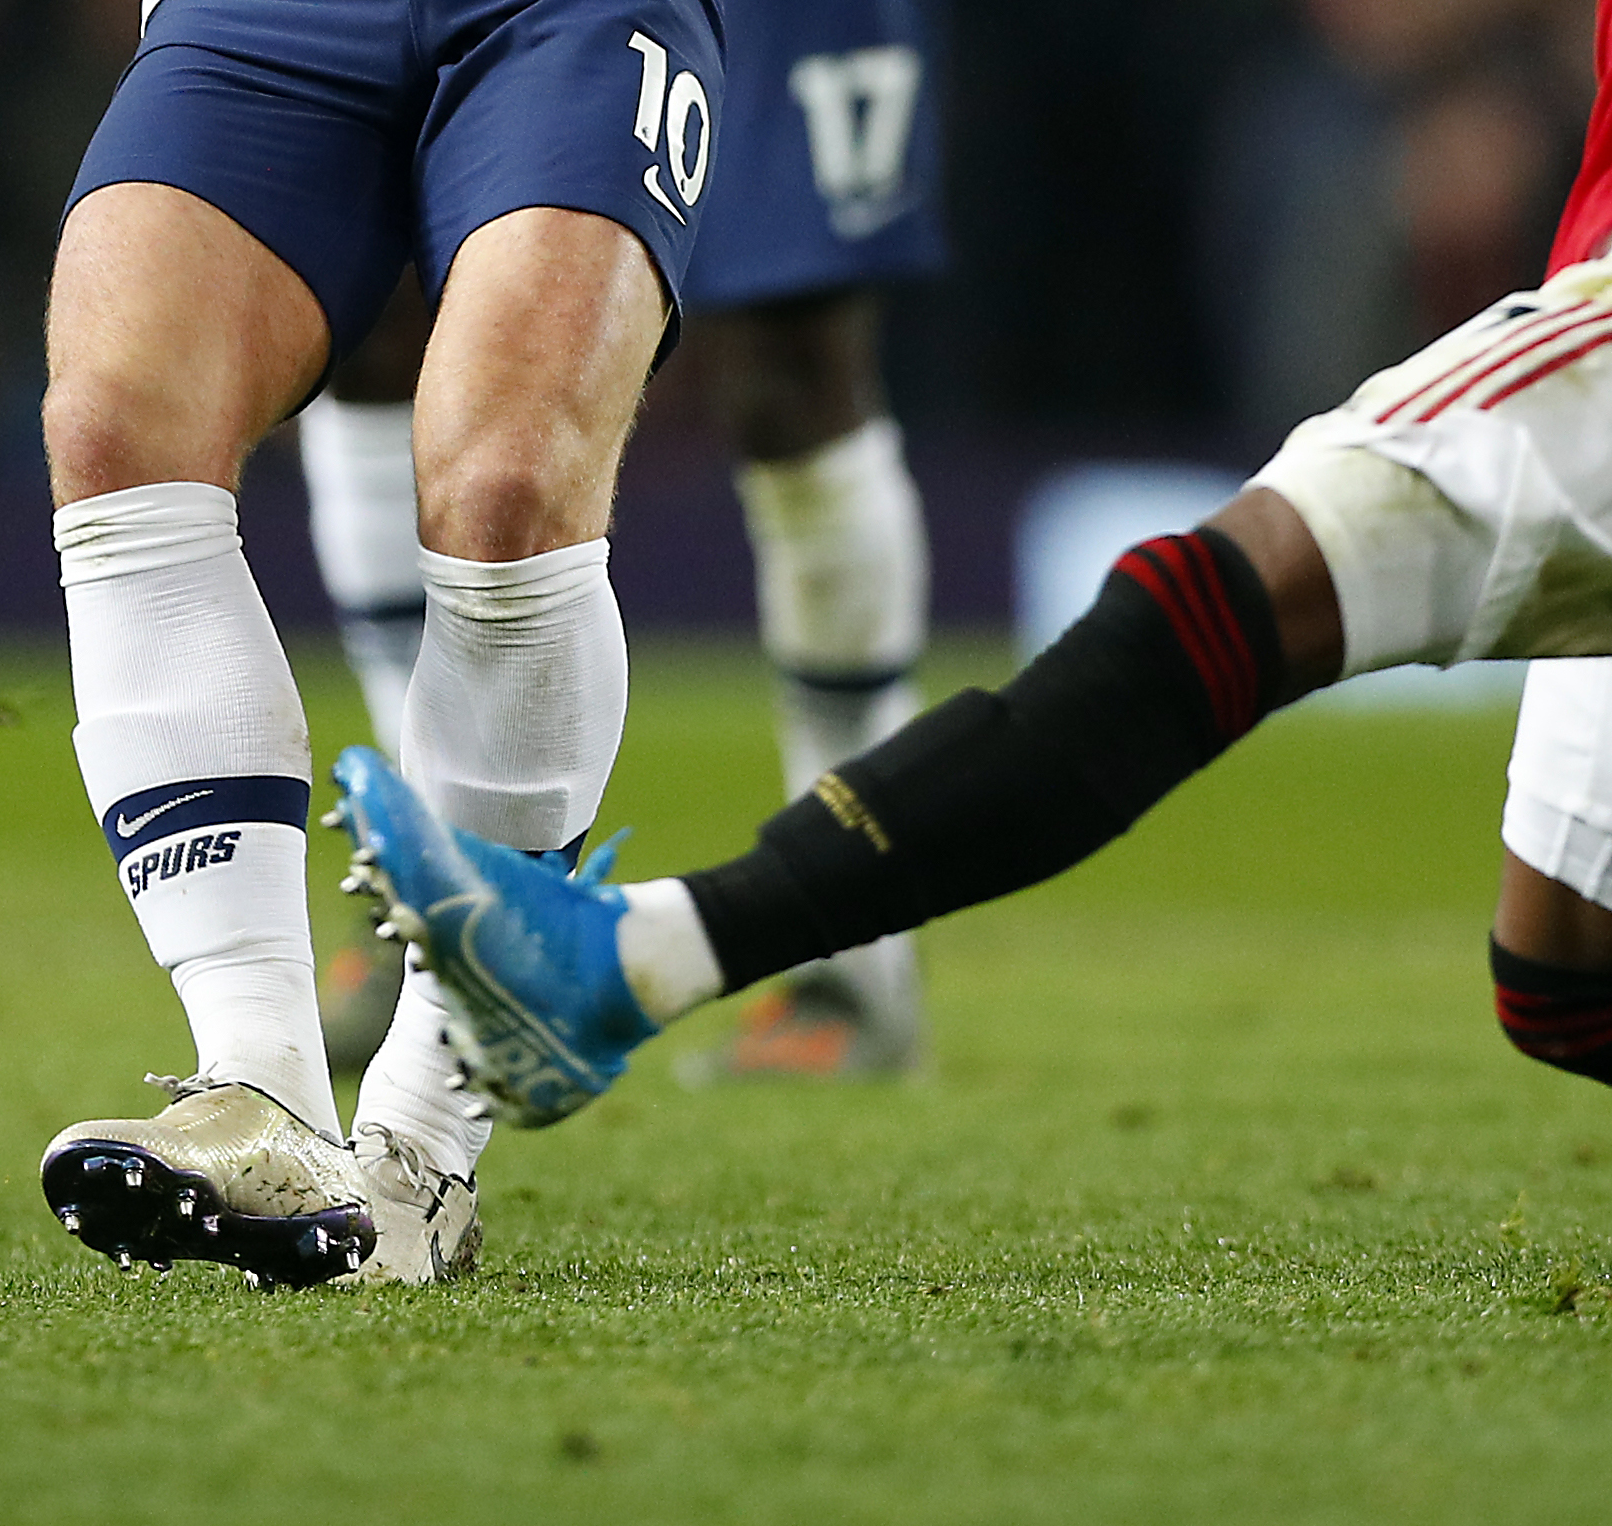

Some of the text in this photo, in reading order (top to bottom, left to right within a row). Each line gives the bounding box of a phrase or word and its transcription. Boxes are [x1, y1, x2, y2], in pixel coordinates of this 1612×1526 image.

[627, 30, 710, 207] 10
[789, 47, 920, 198] 17
[128, 831, 241, 899] SPURS
